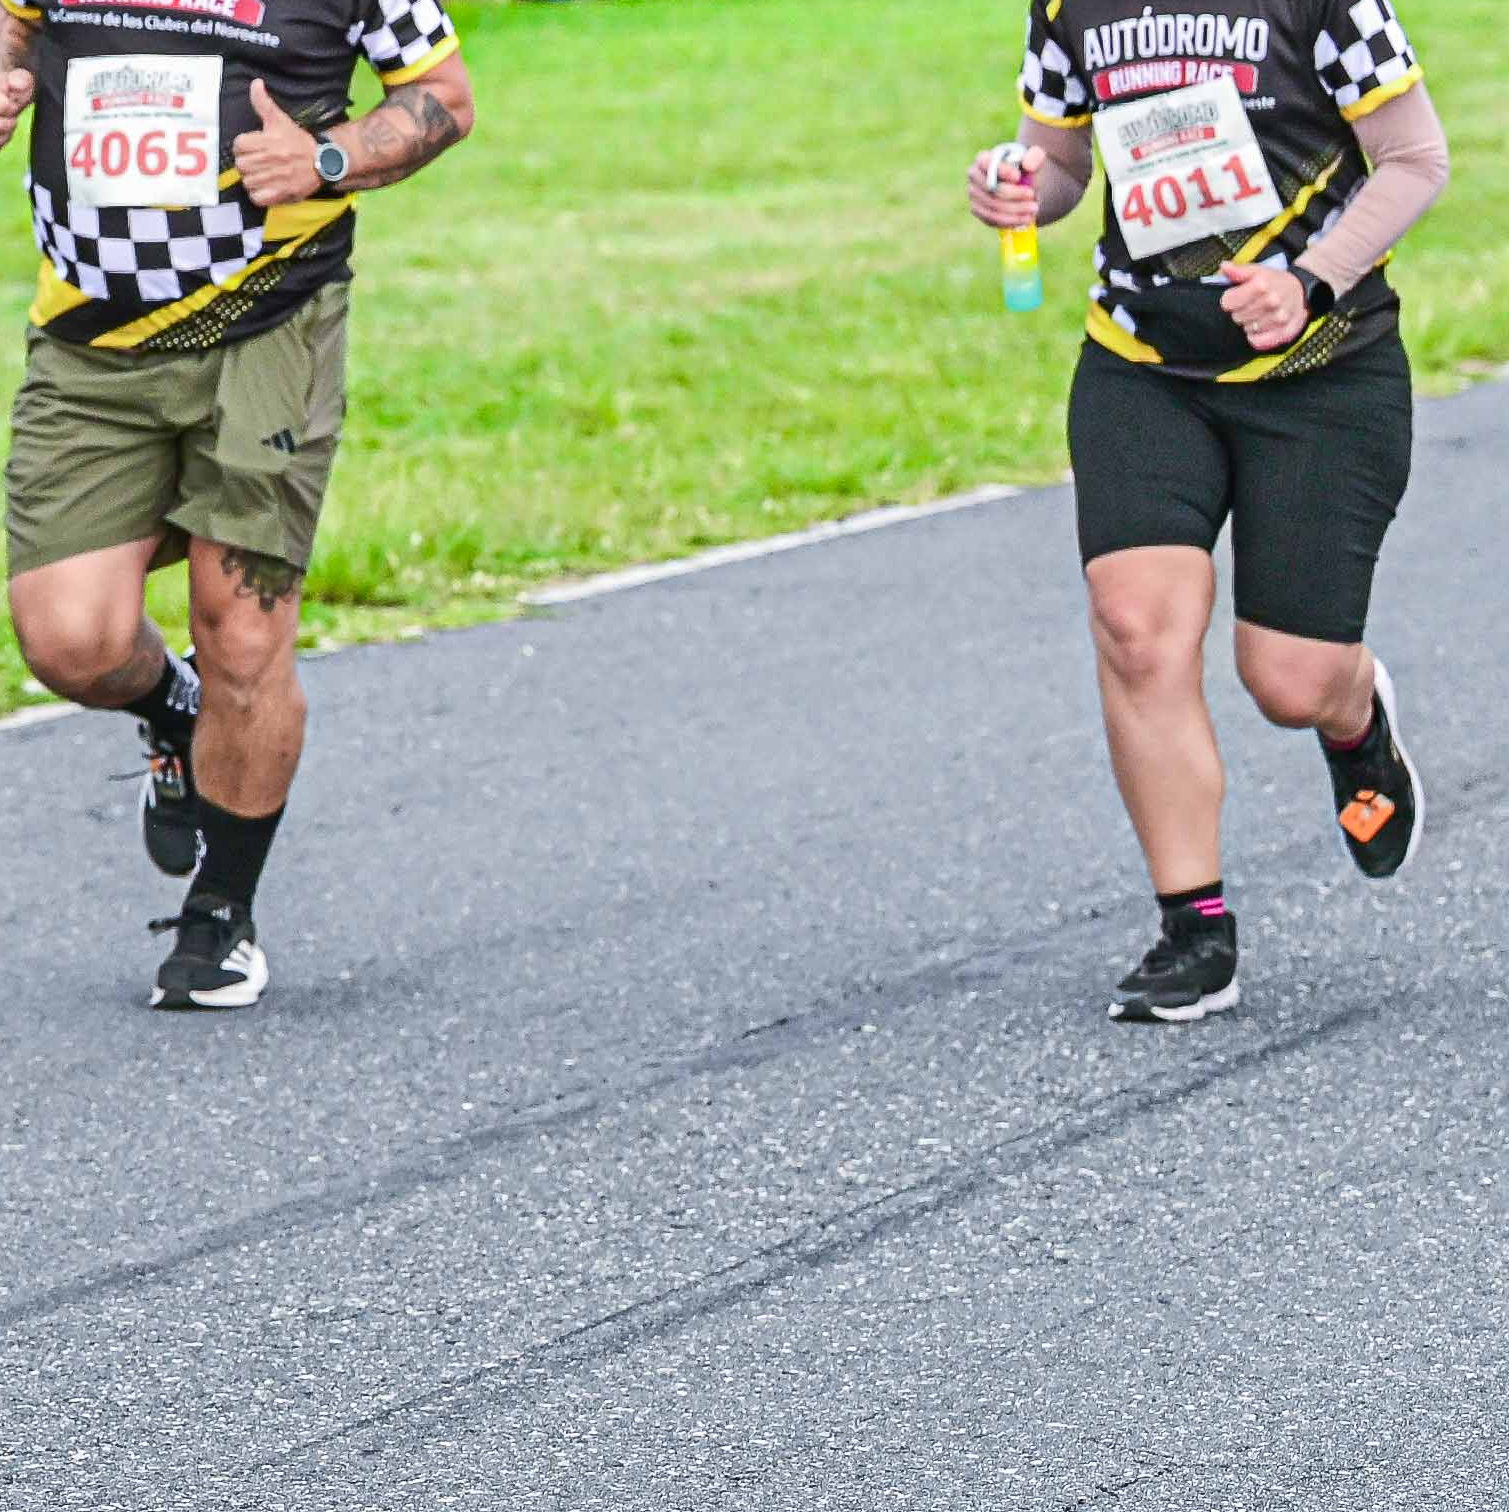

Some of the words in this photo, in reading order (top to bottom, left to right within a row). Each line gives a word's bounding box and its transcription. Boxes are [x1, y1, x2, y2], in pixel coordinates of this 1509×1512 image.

[103, 10, 121, 27] de
[122, 12, 143, 29] los
[145, 14, 190, 33] Clubes
[191, 18, 212, 35] del
[214, 22, 281, 48] Noroeste
[1083, 5, 1269, 71] AUTÓDROMO
[1108, 61, 1181, 94] RUNNING
[70, 130, 208, 178] 4065
[1122, 154, 1263, 228] 4011
